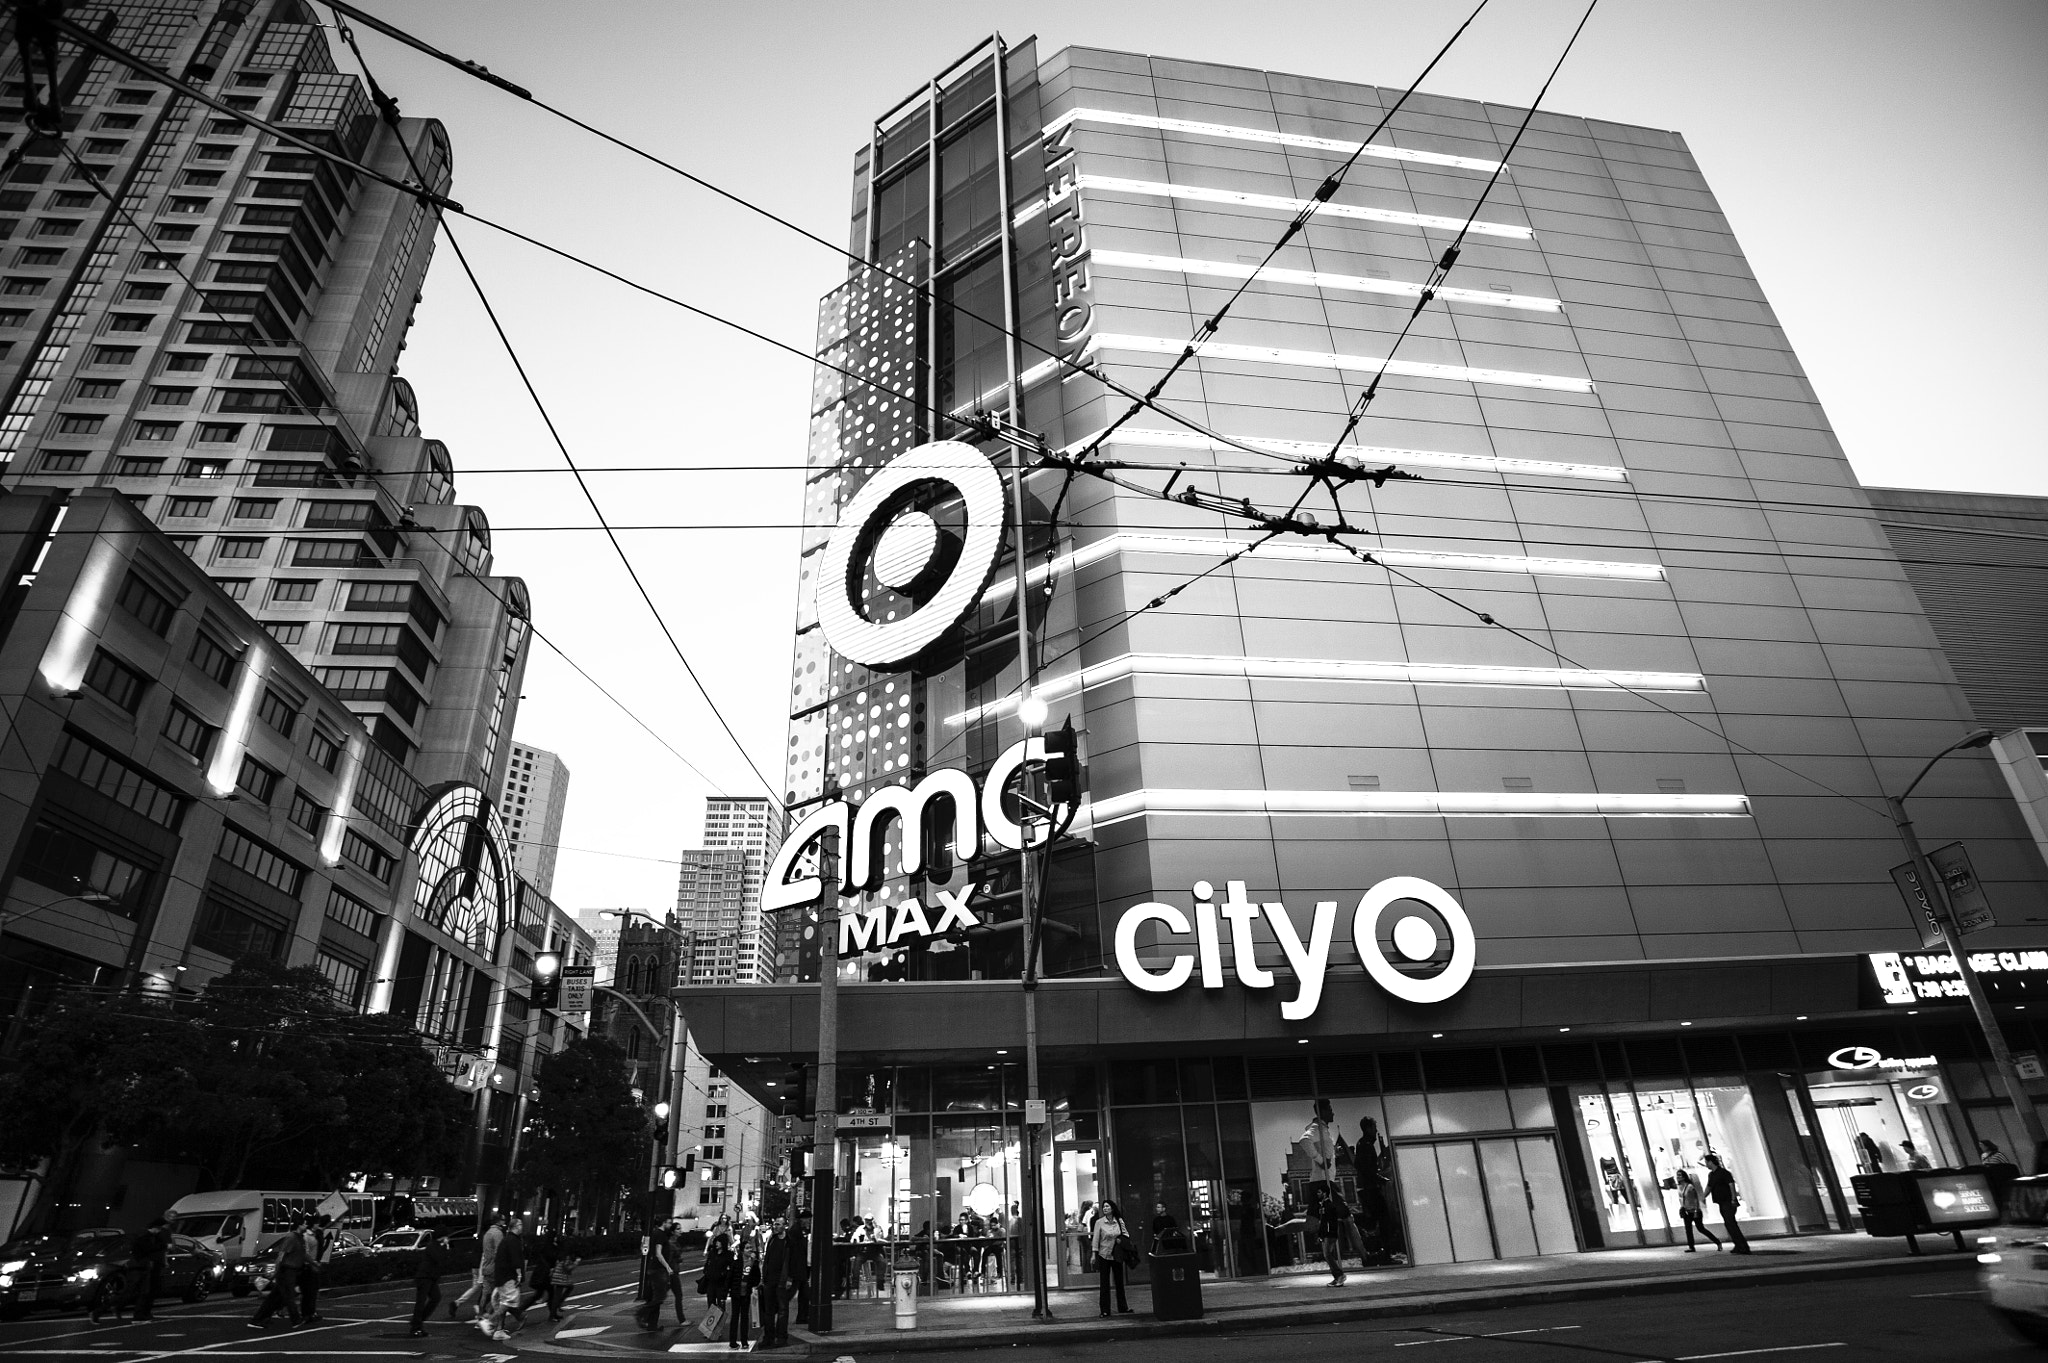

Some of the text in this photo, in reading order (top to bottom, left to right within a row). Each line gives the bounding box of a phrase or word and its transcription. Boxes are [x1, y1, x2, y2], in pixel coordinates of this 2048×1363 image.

[1043, 122, 1094, 384] METREON
[839, 884, 980, 954] MAX
[1905, 871, 1940, 936] ORACLE
[1115, 880, 1338, 1020] city
[850, 1118, 879, 1126] 4TH ST
